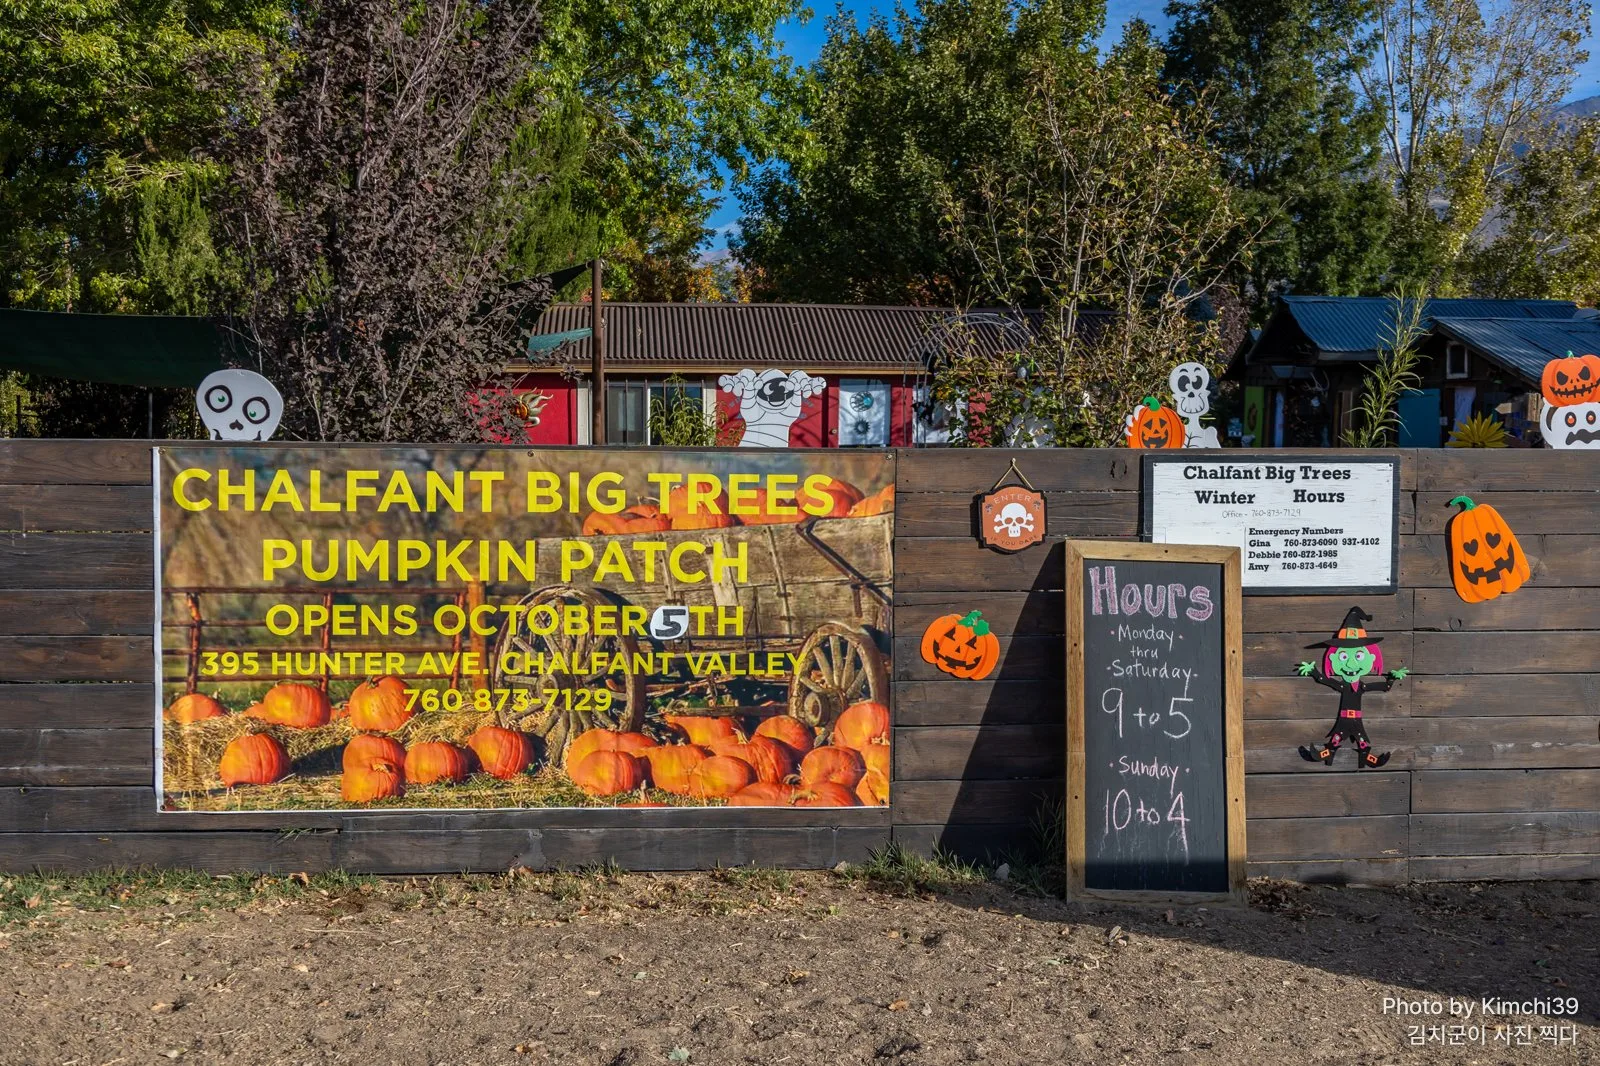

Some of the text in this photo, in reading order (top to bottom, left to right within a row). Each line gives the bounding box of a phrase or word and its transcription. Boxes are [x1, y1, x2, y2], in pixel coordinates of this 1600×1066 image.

[1183, 465, 1351, 483] Chalfant Big Trees
[172, 468, 835, 517] CHALFANT BIG TREES
[994, 493, 1032, 504] ENTER
[1194, 489, 1345, 505] Winter Hours
[1222, 511, 1243, 519] Office
[1248, 527, 1344, 537] Emergency Numbers
[1284, 538, 1338, 547] 760-873-6090
[1341, 537, 1380, 546] 937-4102
[262, 539, 749, 584] PUMPKIN PATCH
[1248, 550, 1338, 559] Debbie 760-872-1985
[1248, 562, 1338, 571] Amy 760-873-4649
[1089, 565, 1214, 622] Hours
[265, 604, 418, 636] OPENS
[433, 604, 648, 637] OCTOBER
[1130, 645, 1159, 659] thru
[201, 652, 808, 675] 395 HUNTER AVE. CHALFANT VALLEY
[403, 688, 612, 712] 760 873-7129
[1101, 687, 1194, 739] 9 to 5
[1118, 755, 1179, 799] Sunday
[1104, 788, 1191, 862] 10 to 4
